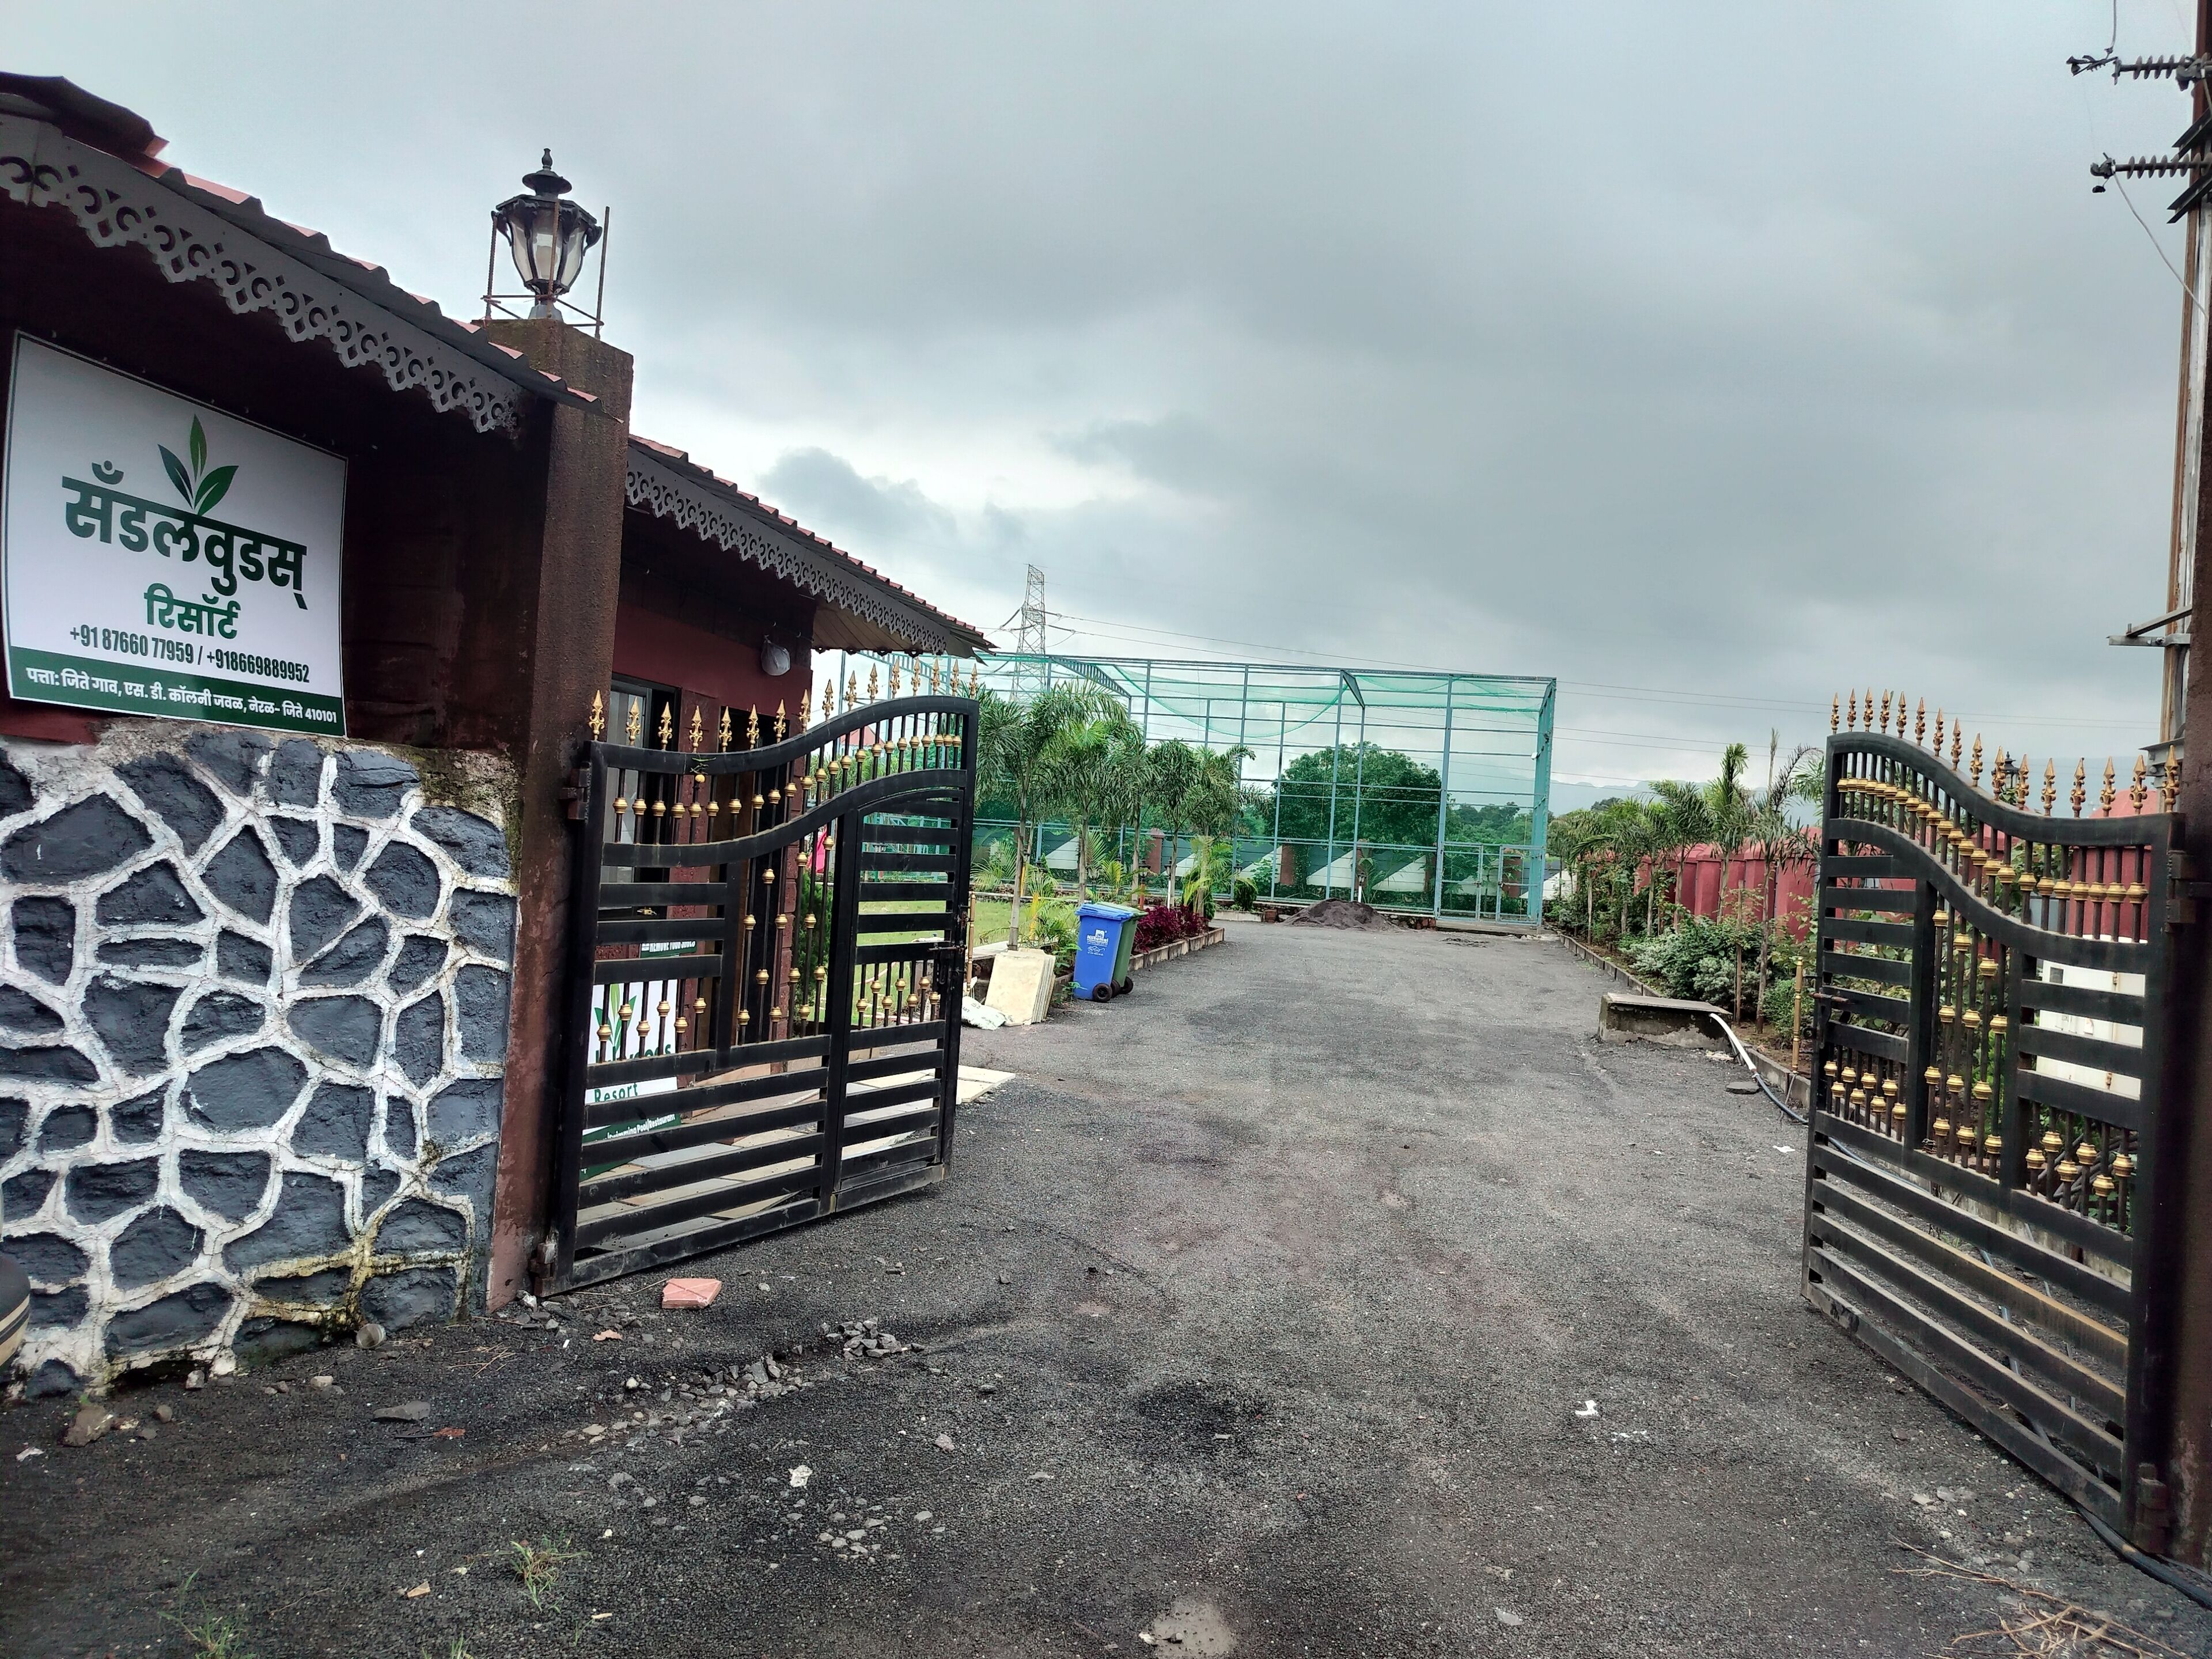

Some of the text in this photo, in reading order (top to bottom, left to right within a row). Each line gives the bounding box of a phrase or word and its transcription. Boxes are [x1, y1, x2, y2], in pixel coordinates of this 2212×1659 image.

[144, 582, 241, 639] रिसॉर्ट
[70, 624, 99, 648] +91
[102, 628, 149, 657] 87660
[151, 637, 194, 664] 77959
[207, 649, 310, 683] +918669889952
[25, 666, 59, 686] पत्ता:
[60, 668, 90, 691] जिते
[91, 675, 123, 697] गाव,
[123, 681, 149, 699] एस.
[149, 681, 167, 701] डी.
[168, 684, 213, 707] कॉलनी
[213, 694, 248, 714] जवळ,
[282, 700, 304, 719] जिते
[304, 707, 338, 724] 410101
[594, 1082, 638, 1103] Resort
